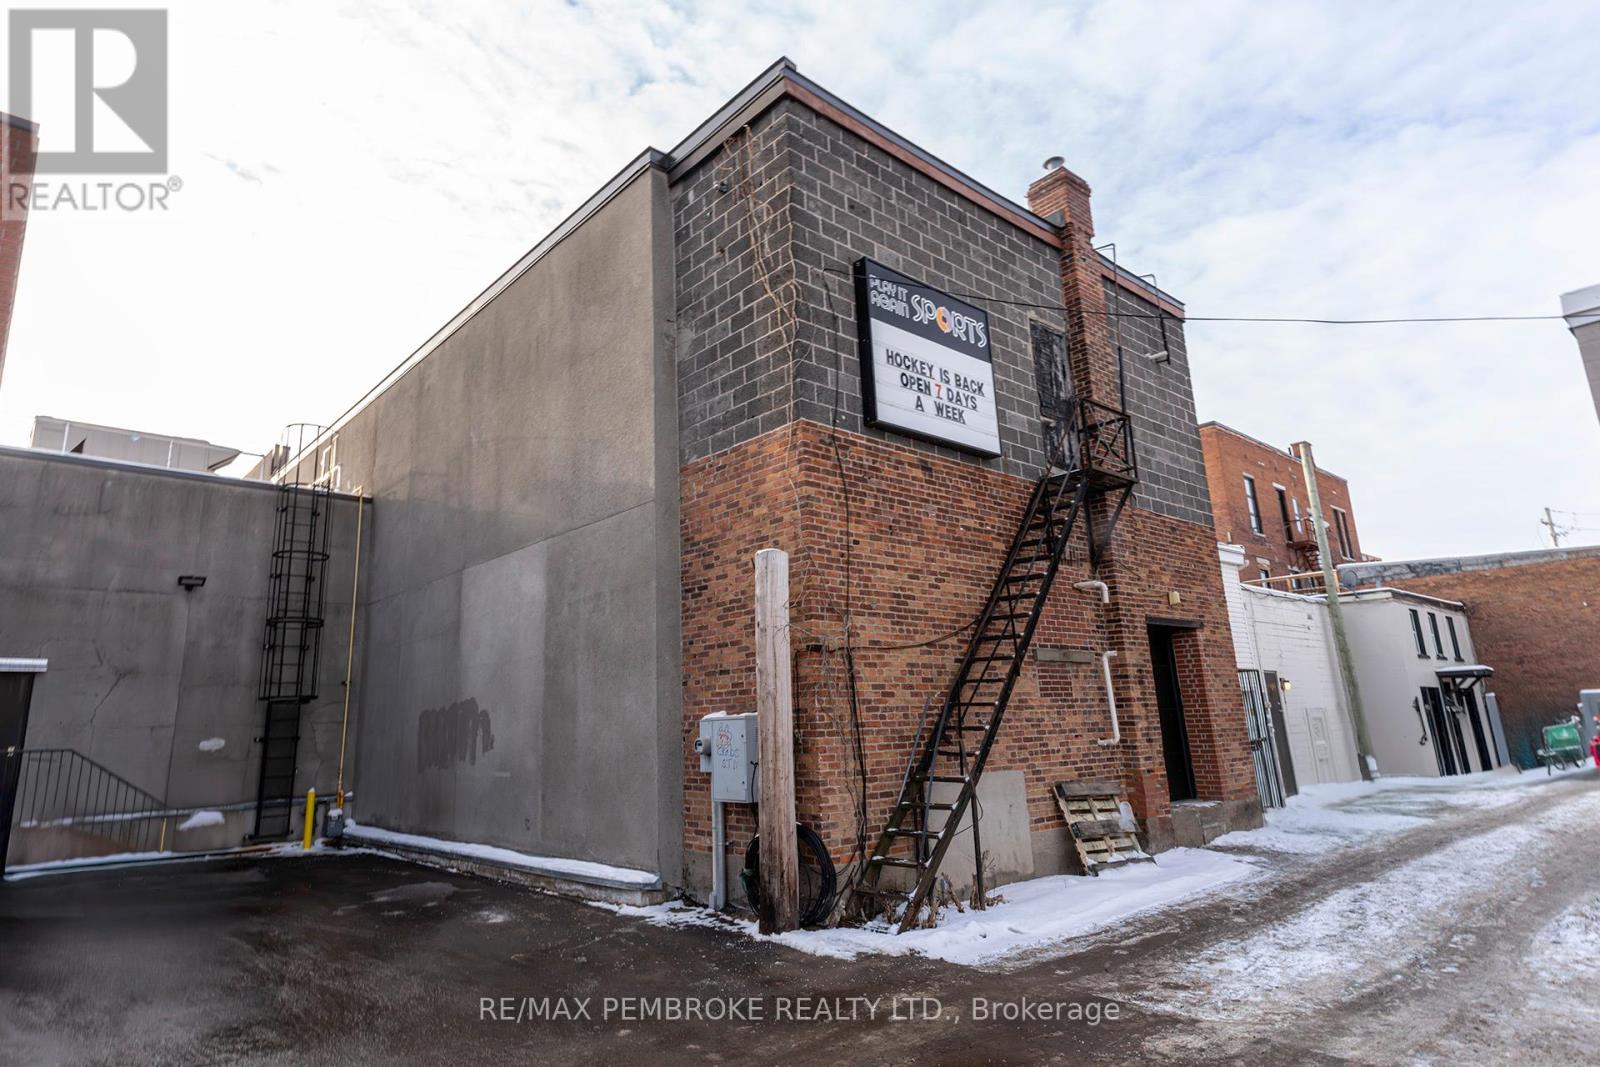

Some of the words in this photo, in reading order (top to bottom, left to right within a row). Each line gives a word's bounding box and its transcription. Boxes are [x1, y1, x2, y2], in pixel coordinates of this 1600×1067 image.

[869, 274, 897, 296] PLAY
[897, 286, 909, 302] IT
[911, 294, 988, 348] SPORTS
[886, 348, 935, 380] HOCKEY
[939, 368, 951, 385] IS
[954, 373, 985, 397] BACK
[900, 373, 932, 396] OPEN
[934, 383, 943, 400] 7
[946, 389, 978, 412] DAYS
[914, 395, 925, 413] A
[934, 400, 966, 425] WEEK
